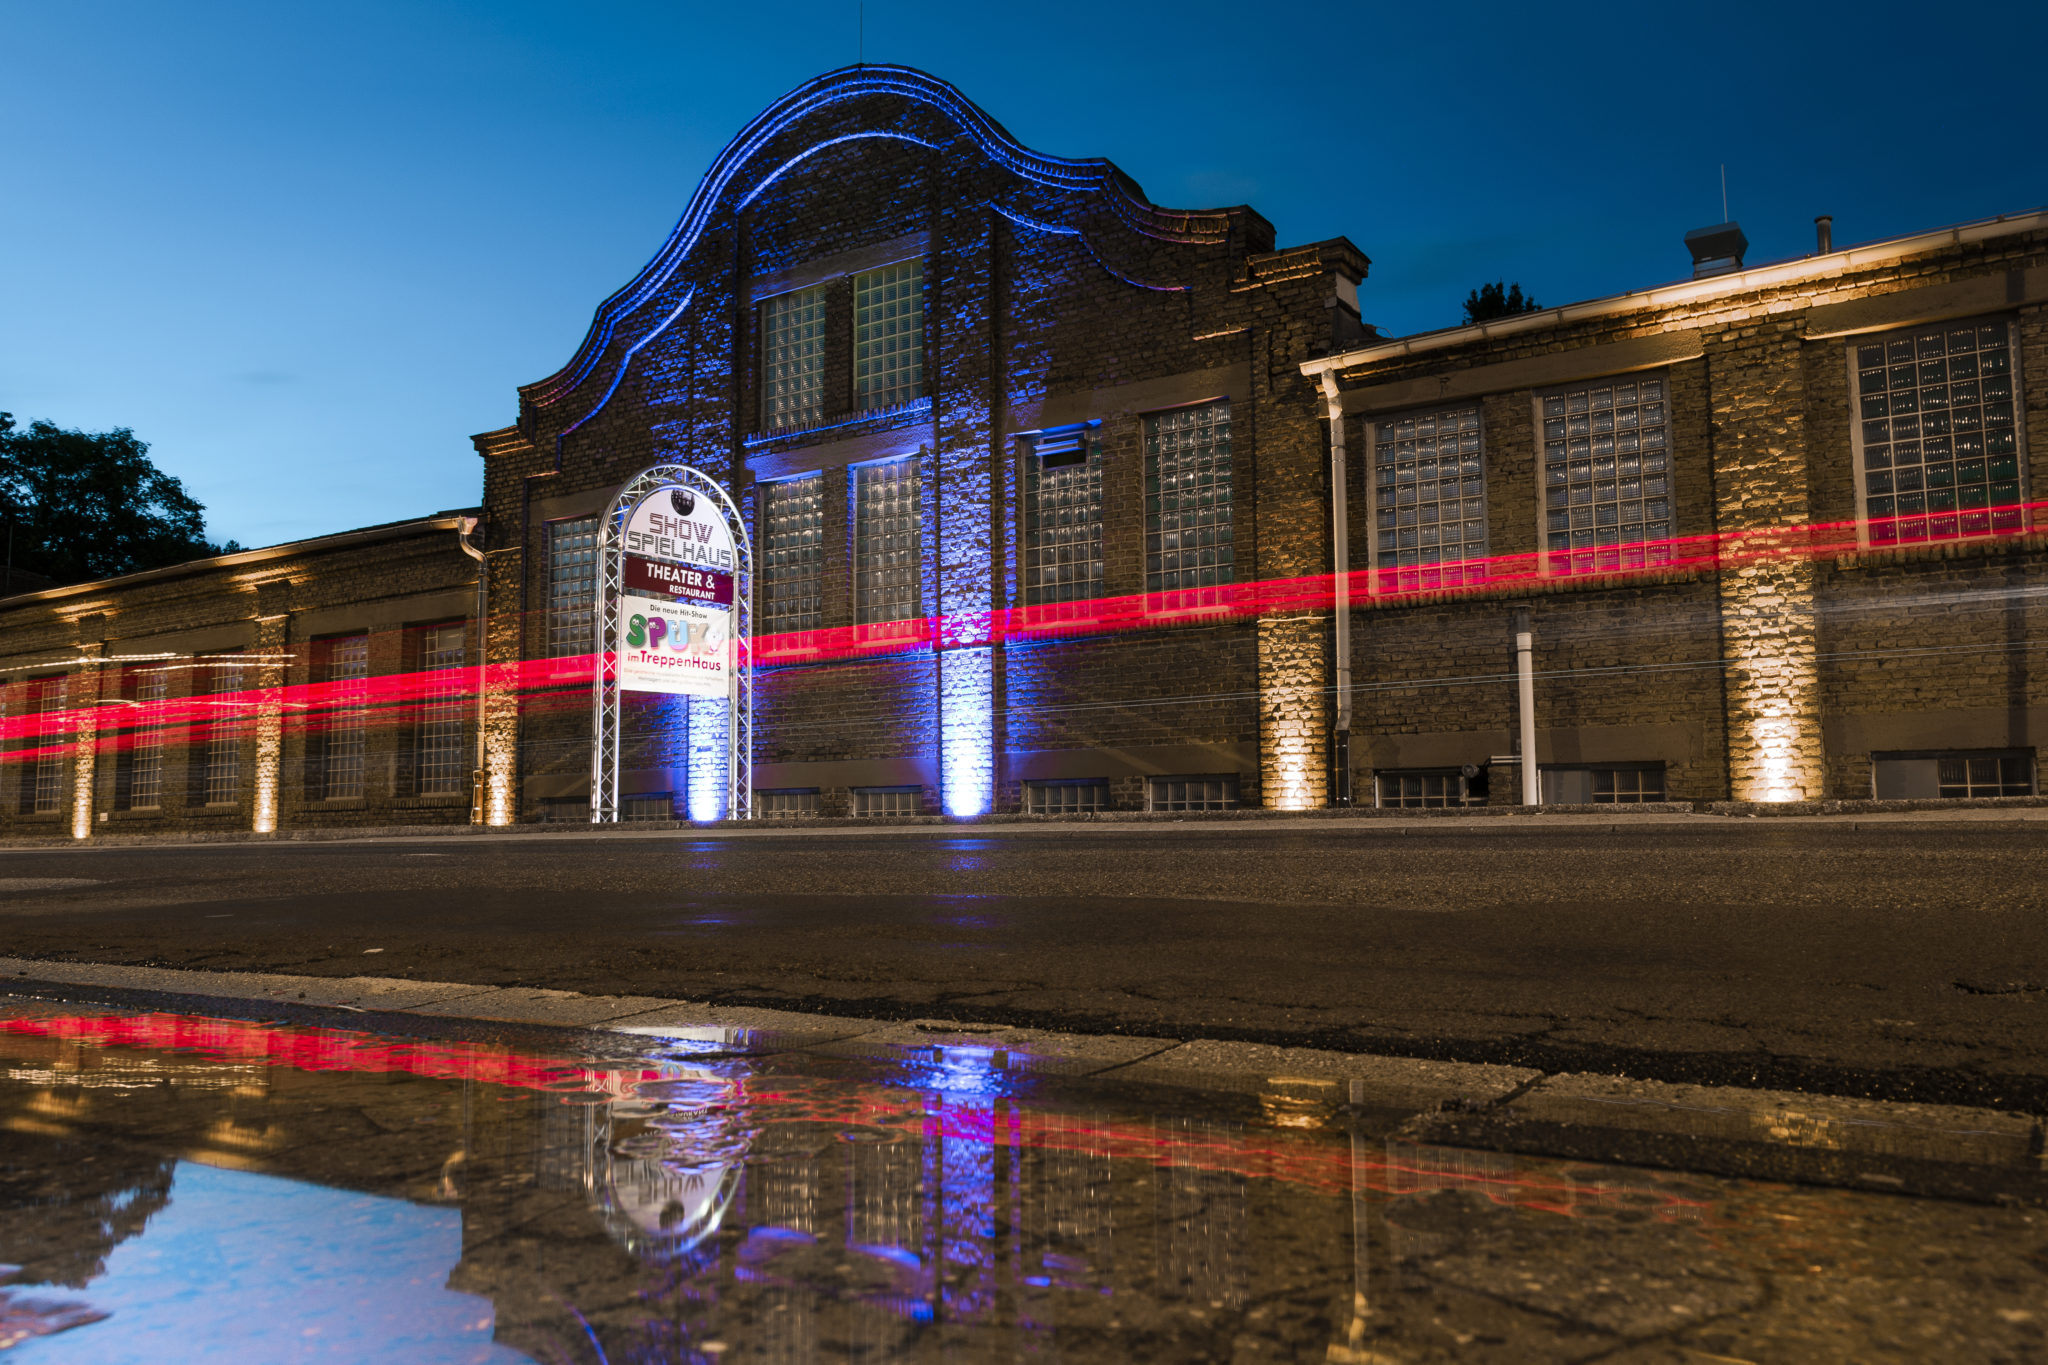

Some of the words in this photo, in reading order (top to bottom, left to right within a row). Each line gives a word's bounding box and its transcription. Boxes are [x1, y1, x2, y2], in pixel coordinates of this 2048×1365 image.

[649, 513, 713, 544] SHOW
[628, 531, 731, 568] SPIELHAUS
[646, 563, 702, 587] THEATER
[705, 575, 715, 589] &
[669, 585, 715, 600] RESTAURANT
[650, 604, 660, 613] Die
[662, 607, 678, 615] neue
[680, 609, 707, 619] Hit-Show
